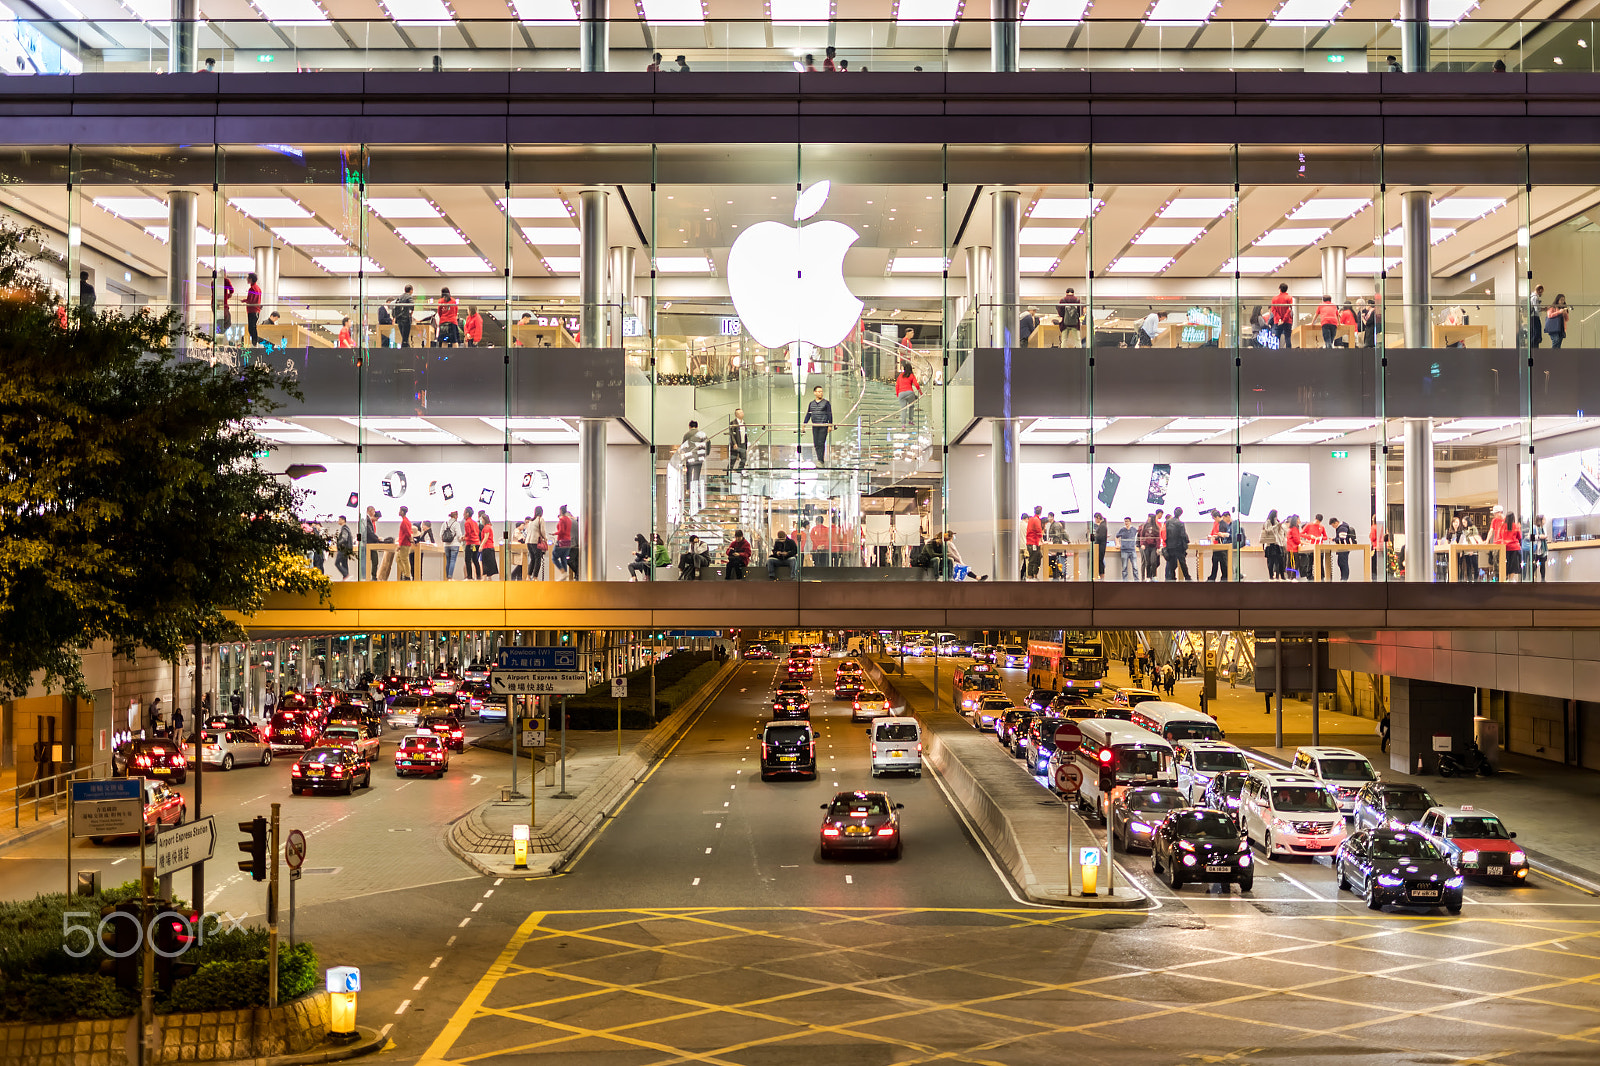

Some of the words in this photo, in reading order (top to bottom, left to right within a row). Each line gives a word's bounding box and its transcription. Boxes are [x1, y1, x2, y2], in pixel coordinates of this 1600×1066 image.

[159, 835, 174, 848] Airport
[175, 830, 193, 843] Express
[193, 826, 208, 837] Station
